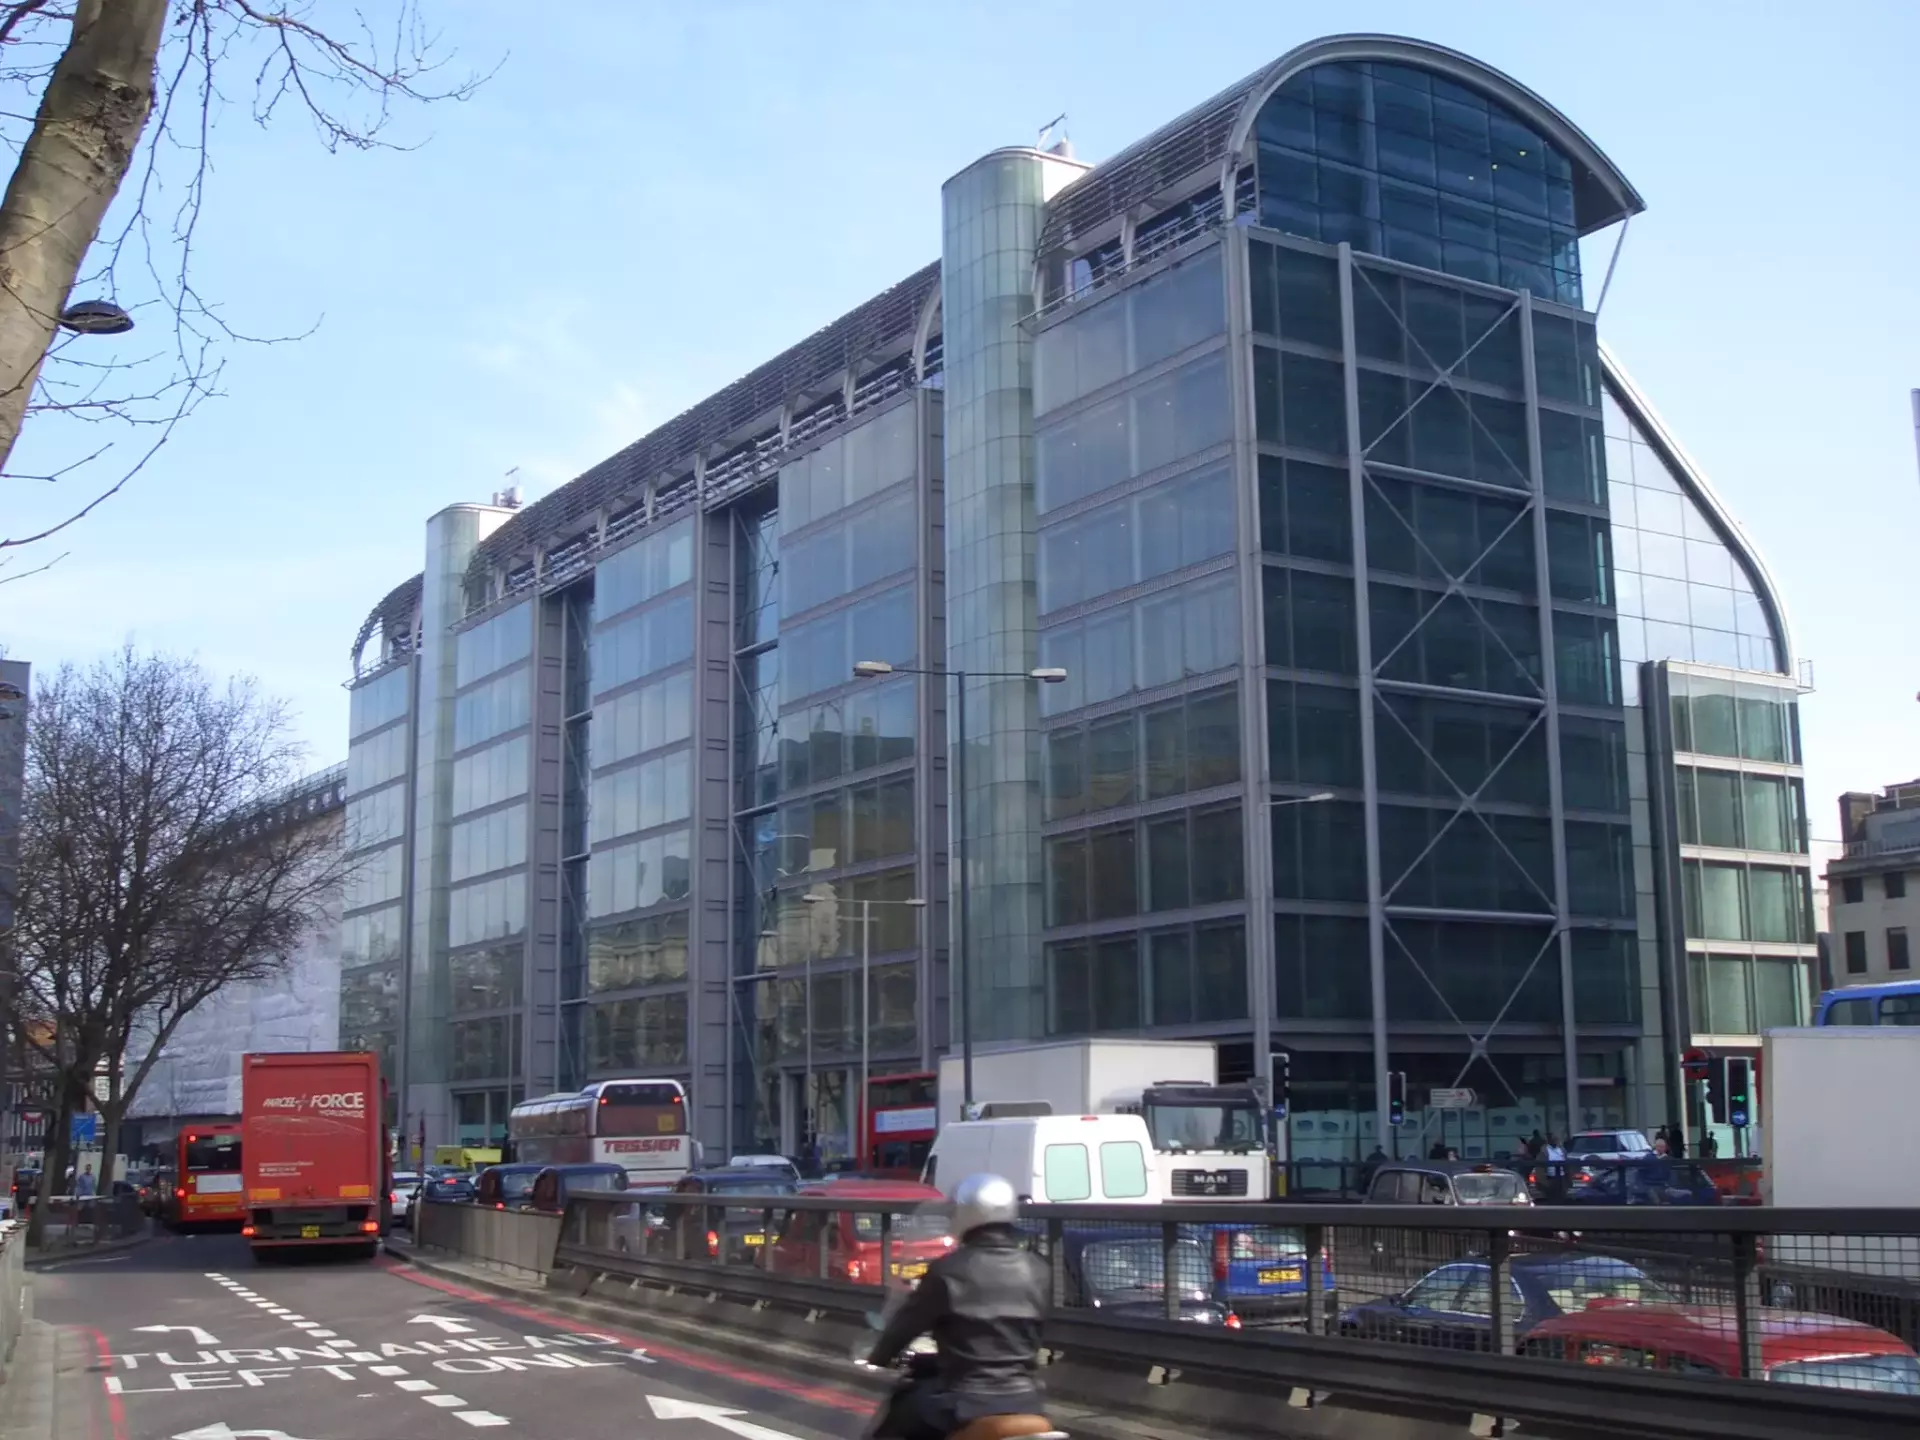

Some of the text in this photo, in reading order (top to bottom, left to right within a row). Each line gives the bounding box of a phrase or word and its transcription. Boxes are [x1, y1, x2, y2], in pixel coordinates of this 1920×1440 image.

[263, 1092, 365, 1109] PARCEL FORCE
[319, 1109, 365, 1119] WORLDWIDE
[603, 1138, 681, 1154] TEISSIER
[1193, 1174, 1229, 1184] MAN
[380, 1332, 622, 1357] AHEAD
[97, 1345, 344, 1369] TURN
[432, 1348, 658, 1374] ONLY
[105, 1364, 358, 1394] LEFT
